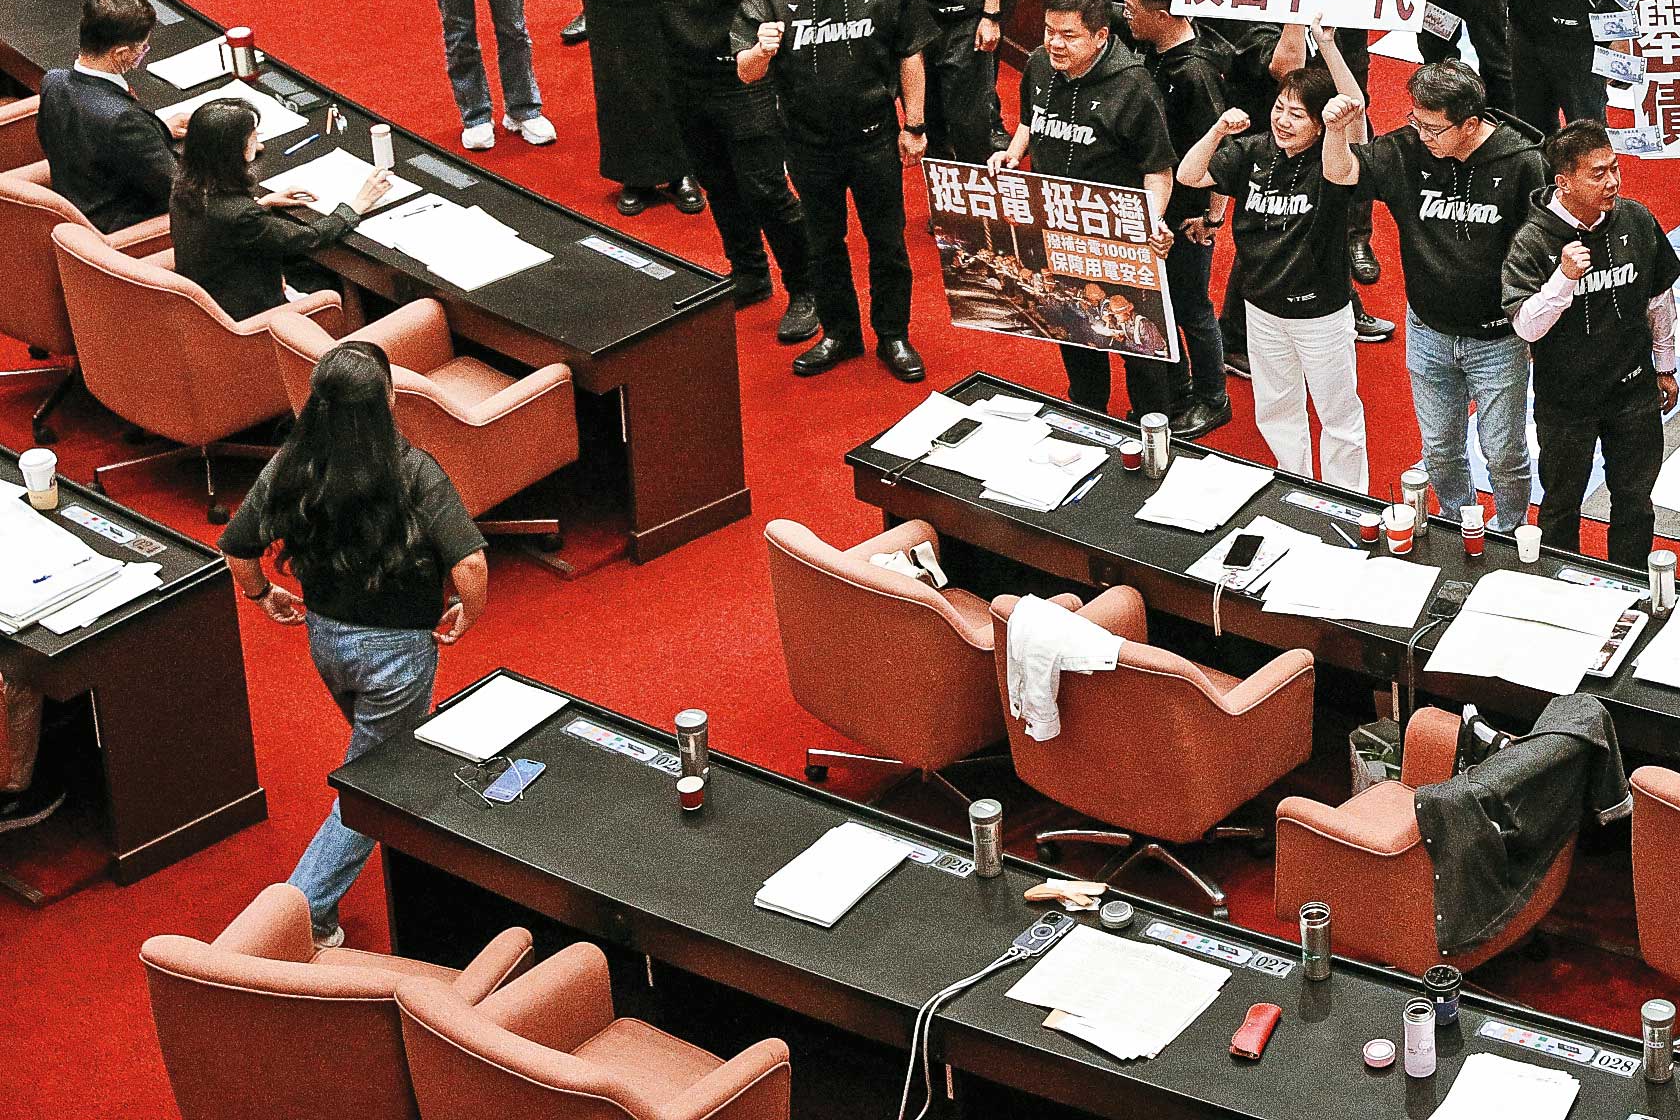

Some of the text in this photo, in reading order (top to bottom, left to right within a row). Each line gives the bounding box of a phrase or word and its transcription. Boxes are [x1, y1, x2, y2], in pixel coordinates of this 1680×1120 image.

[929, 164, 1147, 243] 挺台電 挺台灣
[1050, 252, 1155, 286] 保障用電安全
[1255, 956, 1290, 974] 027
[1597, 1054, 1633, 1073] 028
